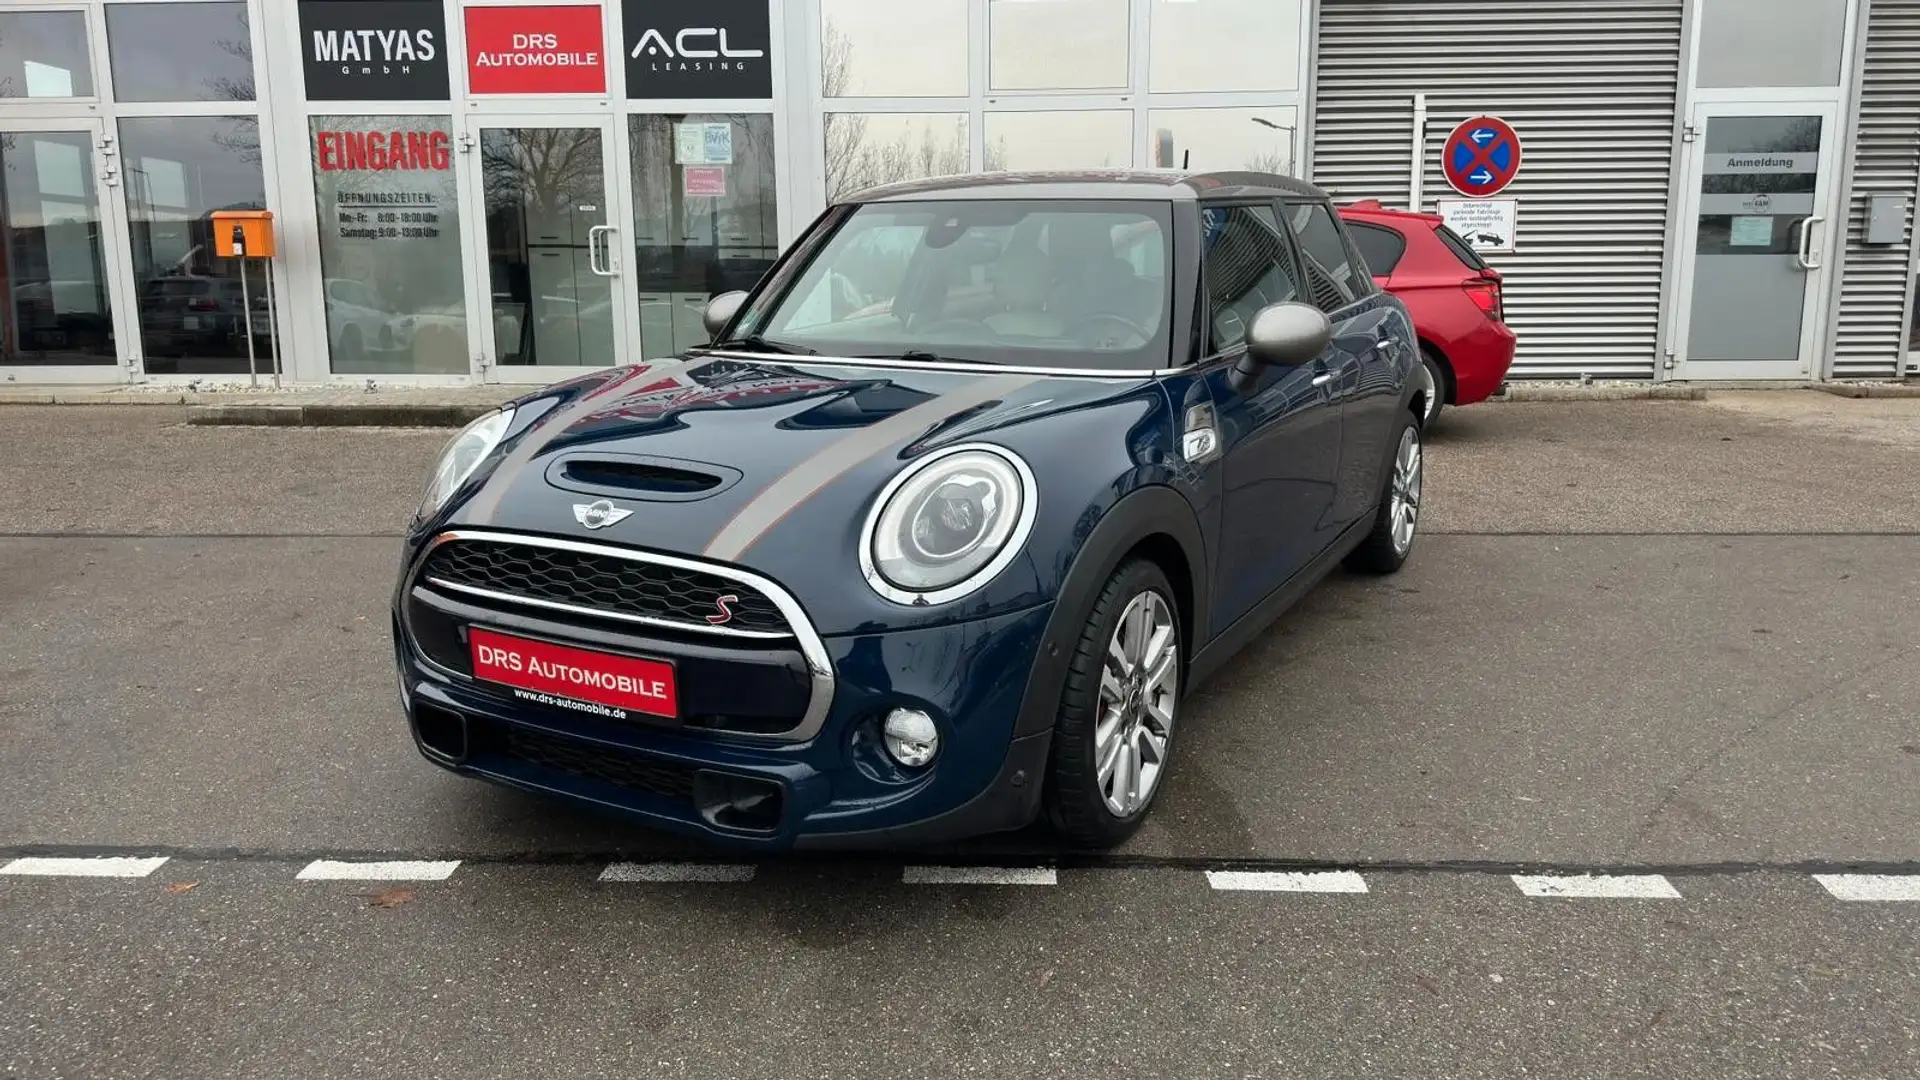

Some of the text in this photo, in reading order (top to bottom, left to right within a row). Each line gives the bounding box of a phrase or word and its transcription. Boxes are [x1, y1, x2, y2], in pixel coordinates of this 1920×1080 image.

[313, 29, 435, 62] MATYAS
[512, 33, 558, 50] DRS
[631, 27, 764, 59] ACL
[341, 66, 410, 74] GmbH
[651, 62, 745, 71] LEASING
[316, 130, 450, 171] EINGANG
[1727, 157, 1794, 168] Anmeldung
[340, 227, 377, 239] Samstag:
[706, 595, 738, 624] S
[478, 644, 522, 671] DRS
[514, 688, 627, 719] www.drs-automobile.de
